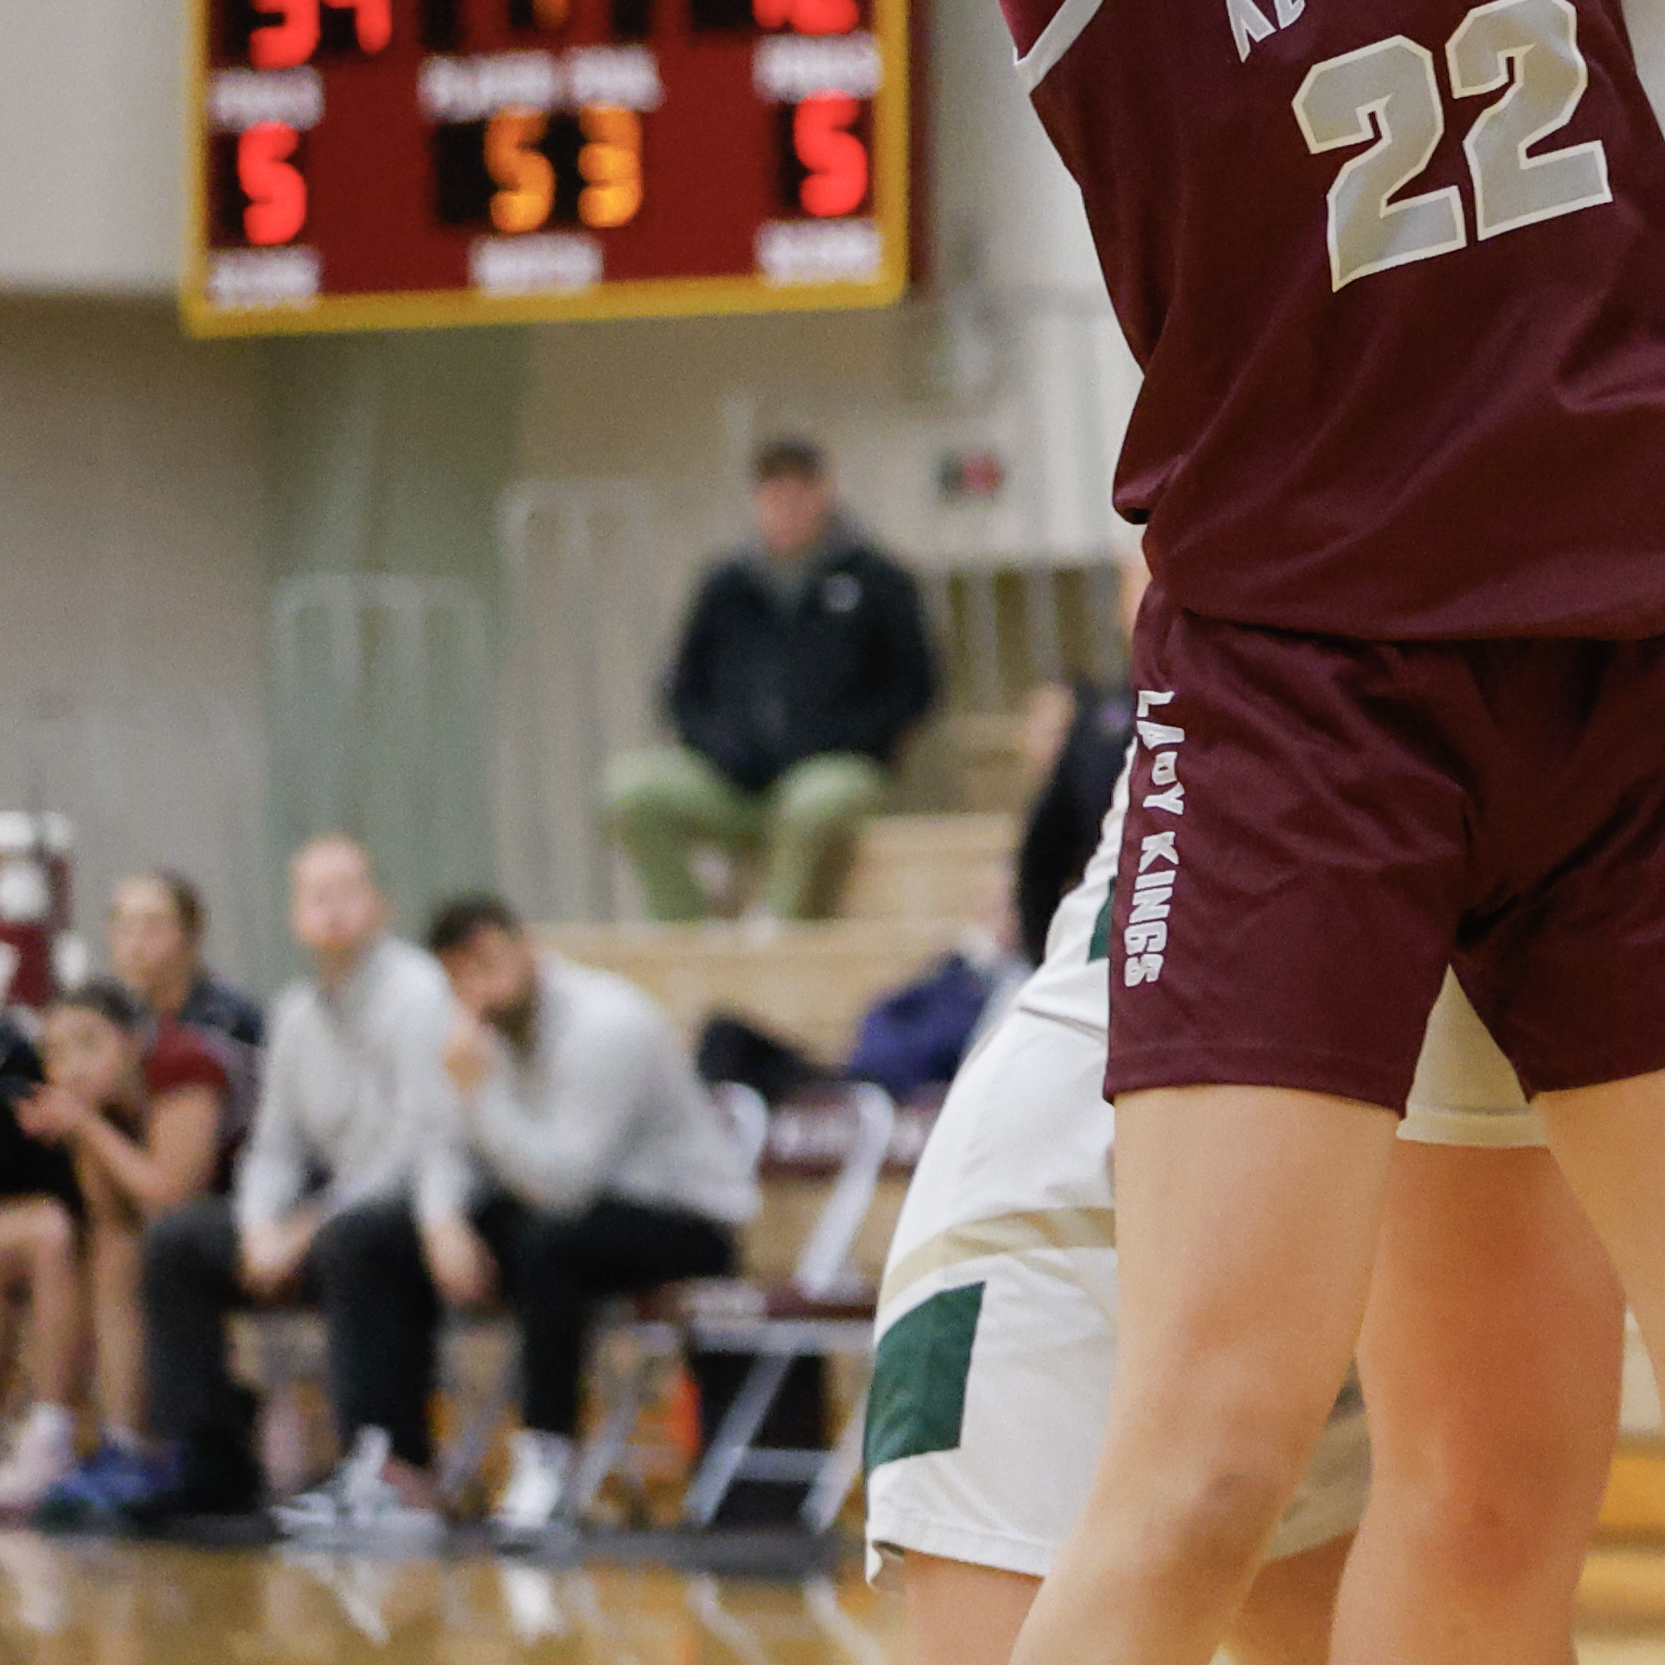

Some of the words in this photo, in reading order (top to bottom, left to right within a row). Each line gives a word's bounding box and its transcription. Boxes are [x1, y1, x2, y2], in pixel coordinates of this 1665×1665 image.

[238, 120, 306, 245] 5
[794, 89, 867, 217] 5
[1136, 690, 1186, 815] LADY
[1124, 831, 1180, 988] KINGS
